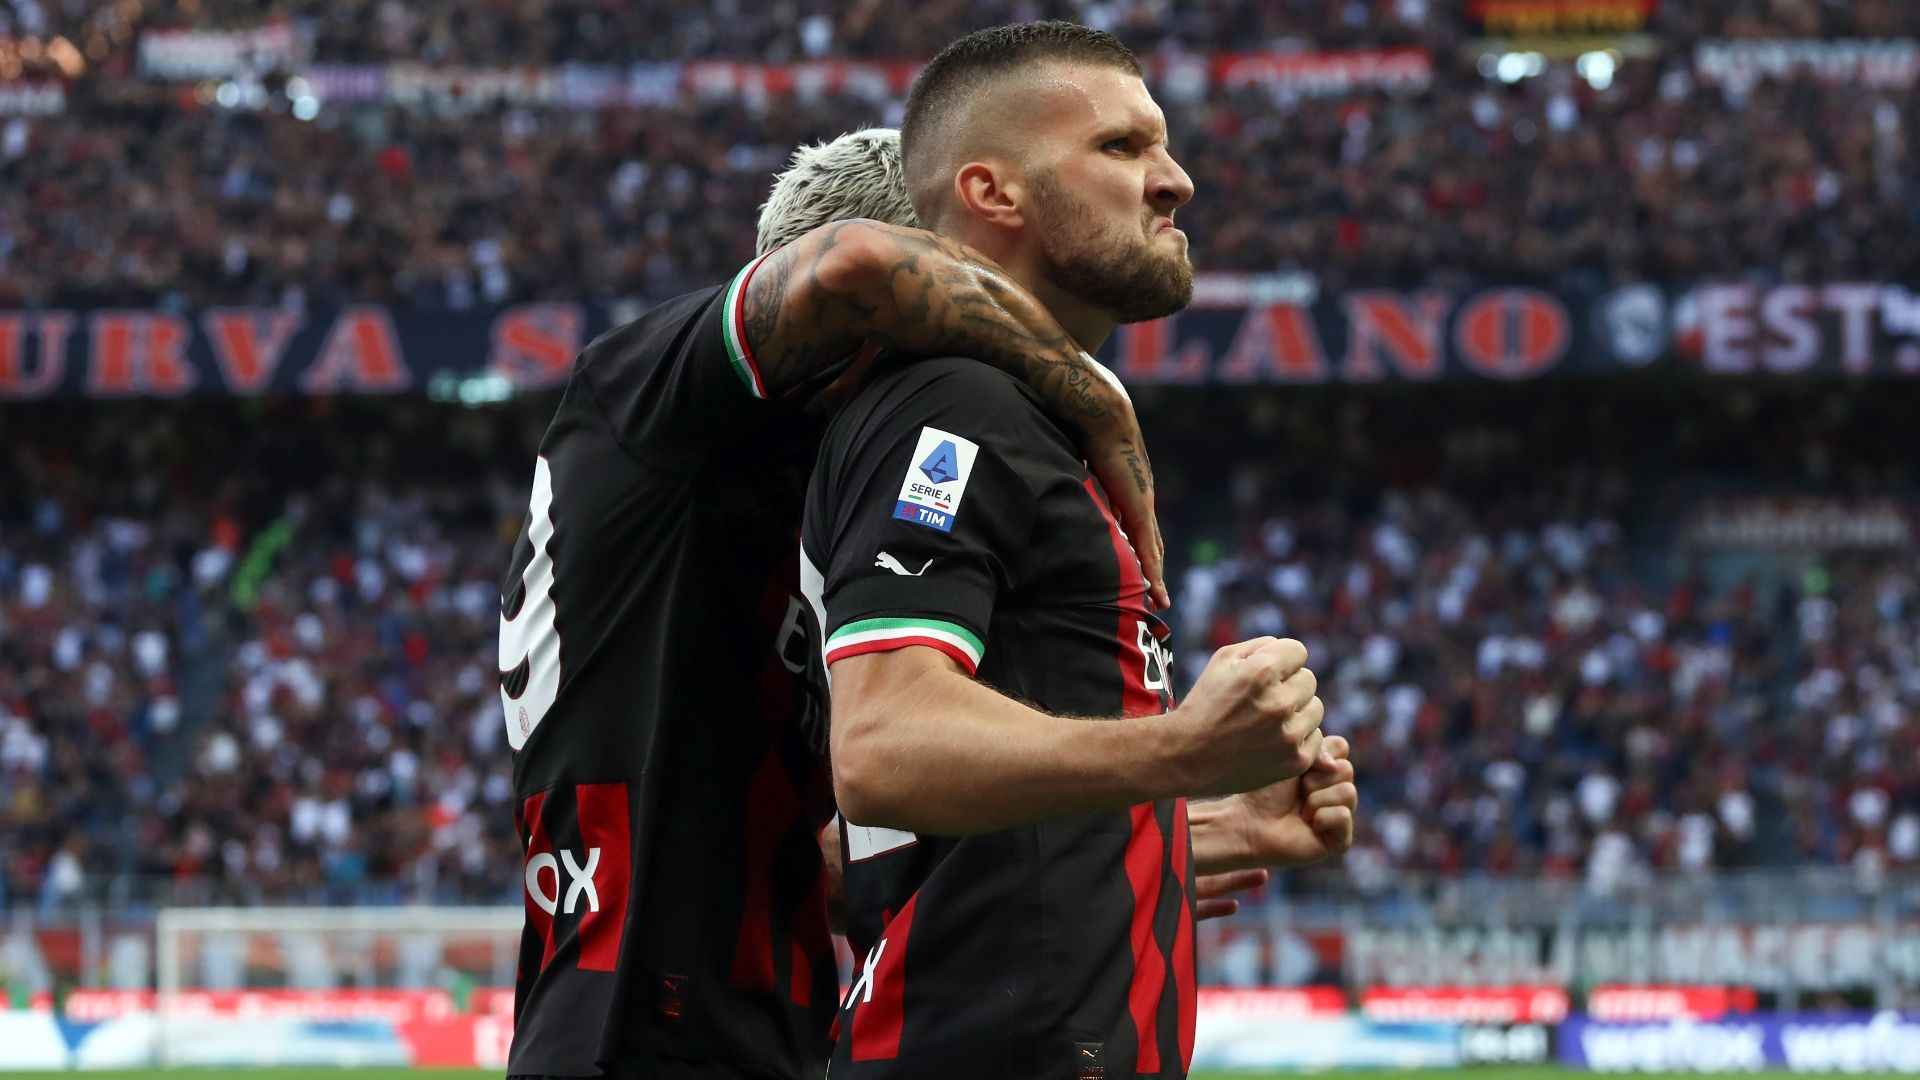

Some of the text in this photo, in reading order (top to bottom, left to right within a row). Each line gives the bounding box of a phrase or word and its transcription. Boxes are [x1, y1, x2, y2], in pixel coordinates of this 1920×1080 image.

[910, 482, 952, 504] SERIE A
[919, 508, 946, 527] TIM
